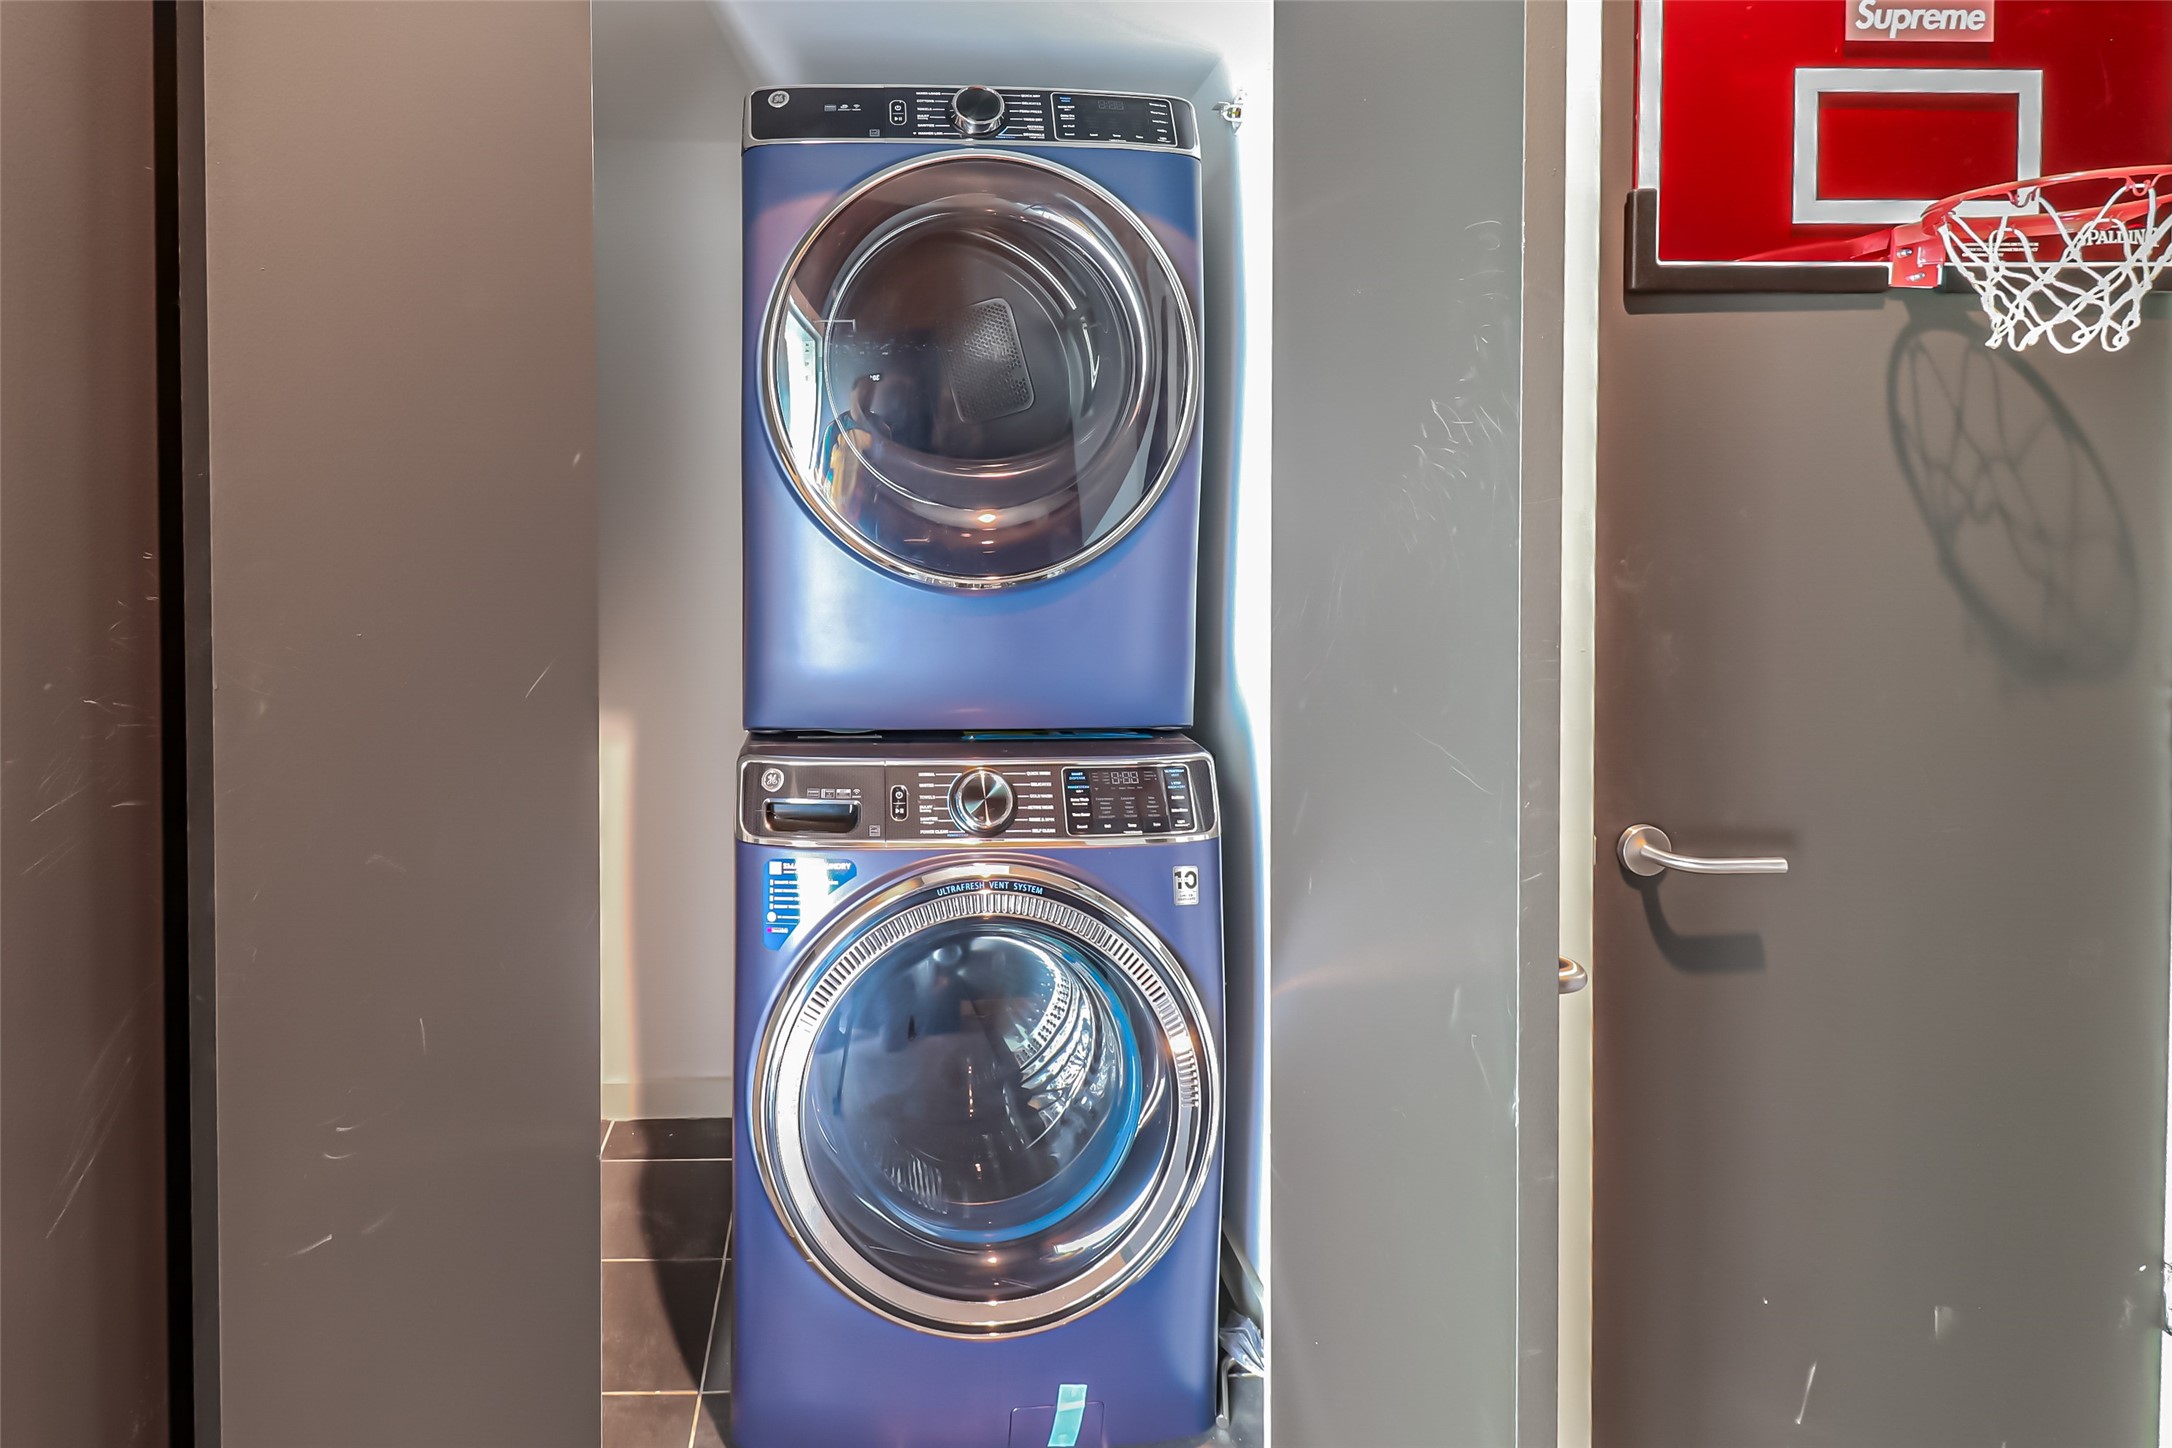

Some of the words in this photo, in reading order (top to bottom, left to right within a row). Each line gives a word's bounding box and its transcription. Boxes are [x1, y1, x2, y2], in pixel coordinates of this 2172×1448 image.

[1855, 0, 1986, 38] Supreme
[2080, 227, 2160, 247] PALIN
[936, 881, 985, 896] ULTRAFRESH
[988, 881, 1010, 890] VENT
[1013, 882, 1043, 895] SYSTEM
